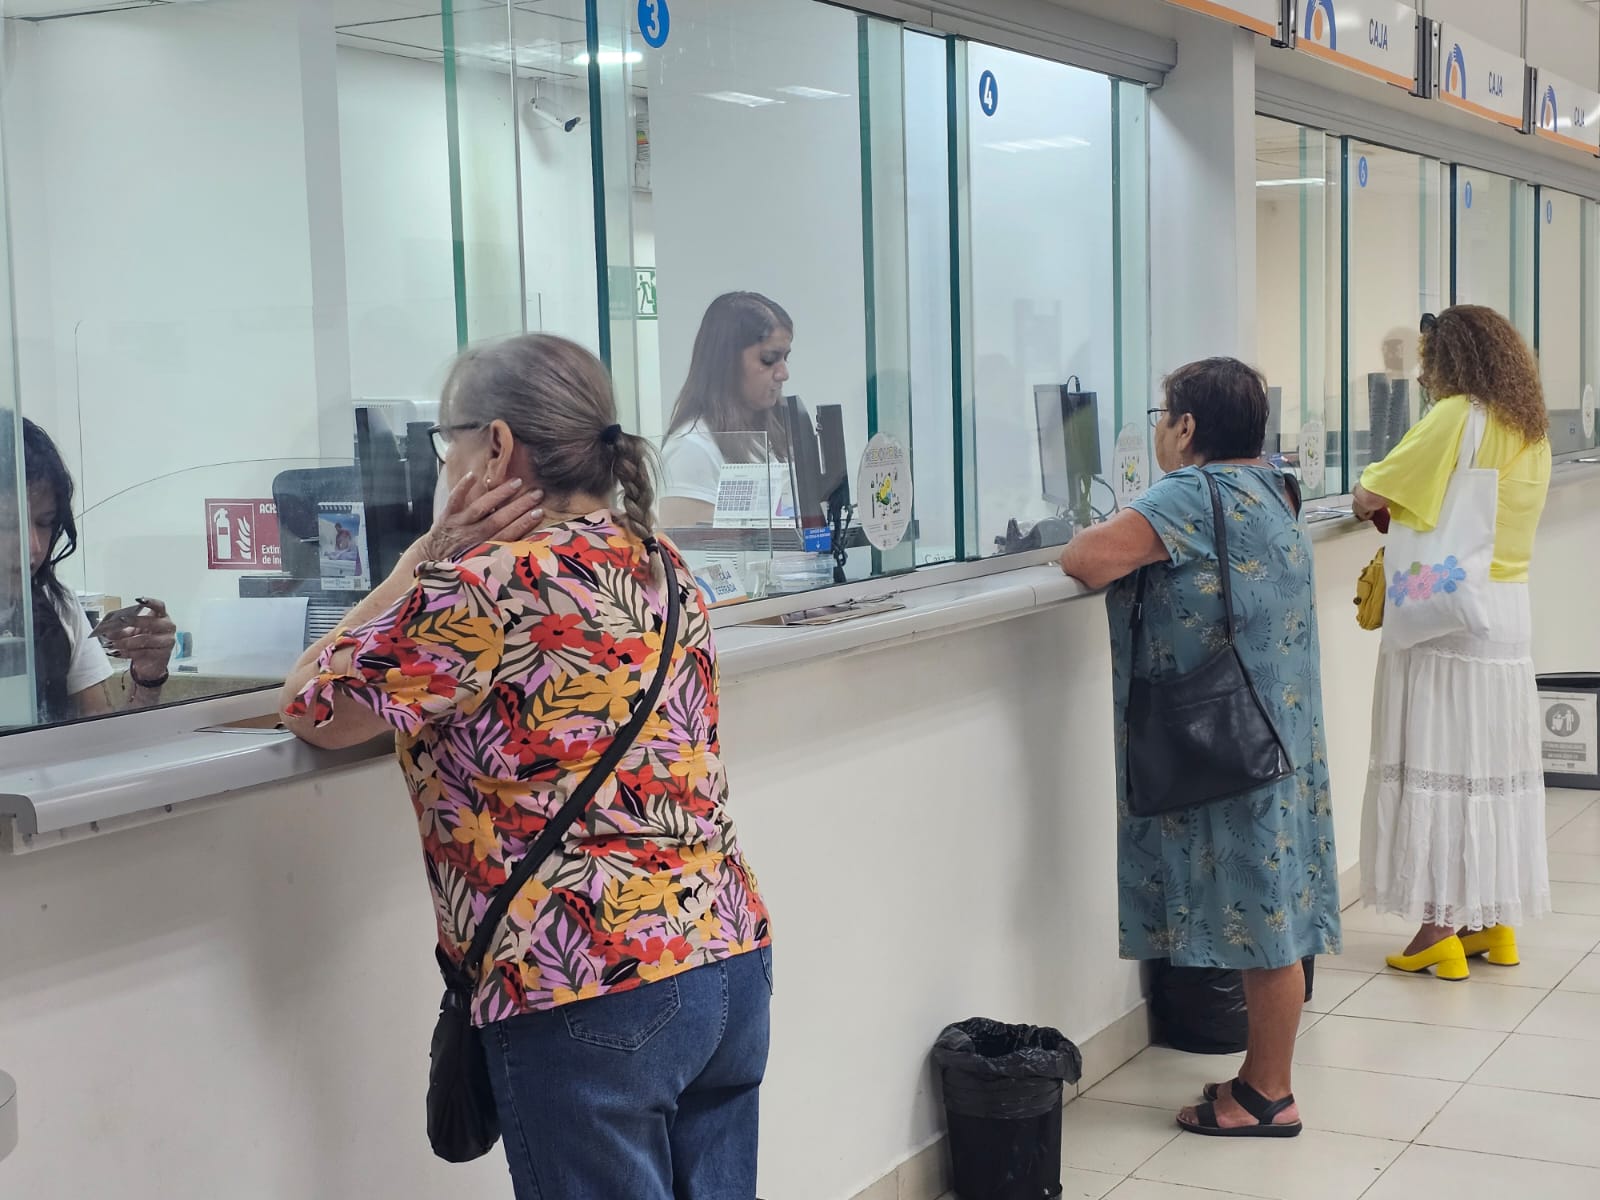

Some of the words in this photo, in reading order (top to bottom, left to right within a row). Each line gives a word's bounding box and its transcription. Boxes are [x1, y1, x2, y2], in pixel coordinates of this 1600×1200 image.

[646, 0, 660, 39] 3
[1369, 18, 1388, 51] CAJA
[983, 76, 993, 110] 4
[1488, 71, 1503, 97] CAJA
[1574, 106, 1585, 127] CAJA
[261, 544, 281, 554] Extin
[262, 555, 271, 565] de
